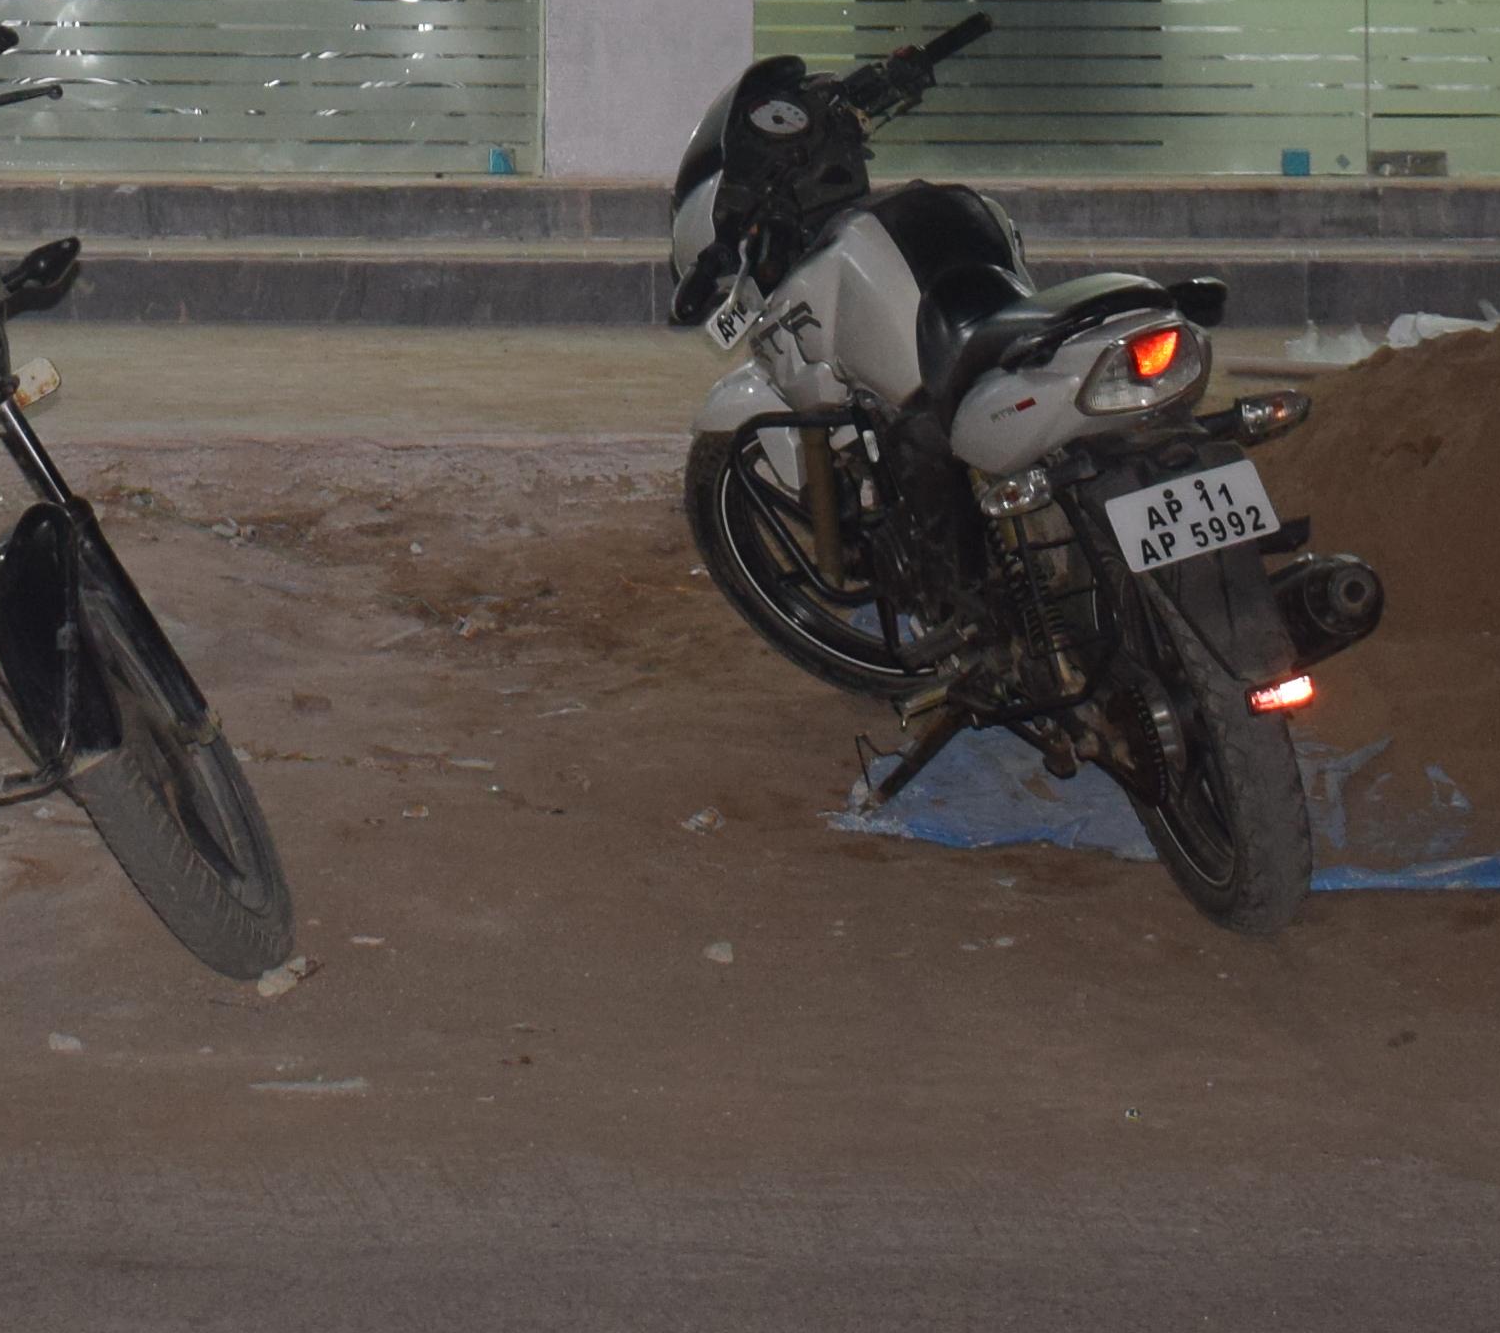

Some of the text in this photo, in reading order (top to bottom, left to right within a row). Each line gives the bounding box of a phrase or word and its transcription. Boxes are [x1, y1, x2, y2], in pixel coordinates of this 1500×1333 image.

[1146, 483, 1234, 530] AP 11
[1140, 505, 1266, 565] AP 5992
